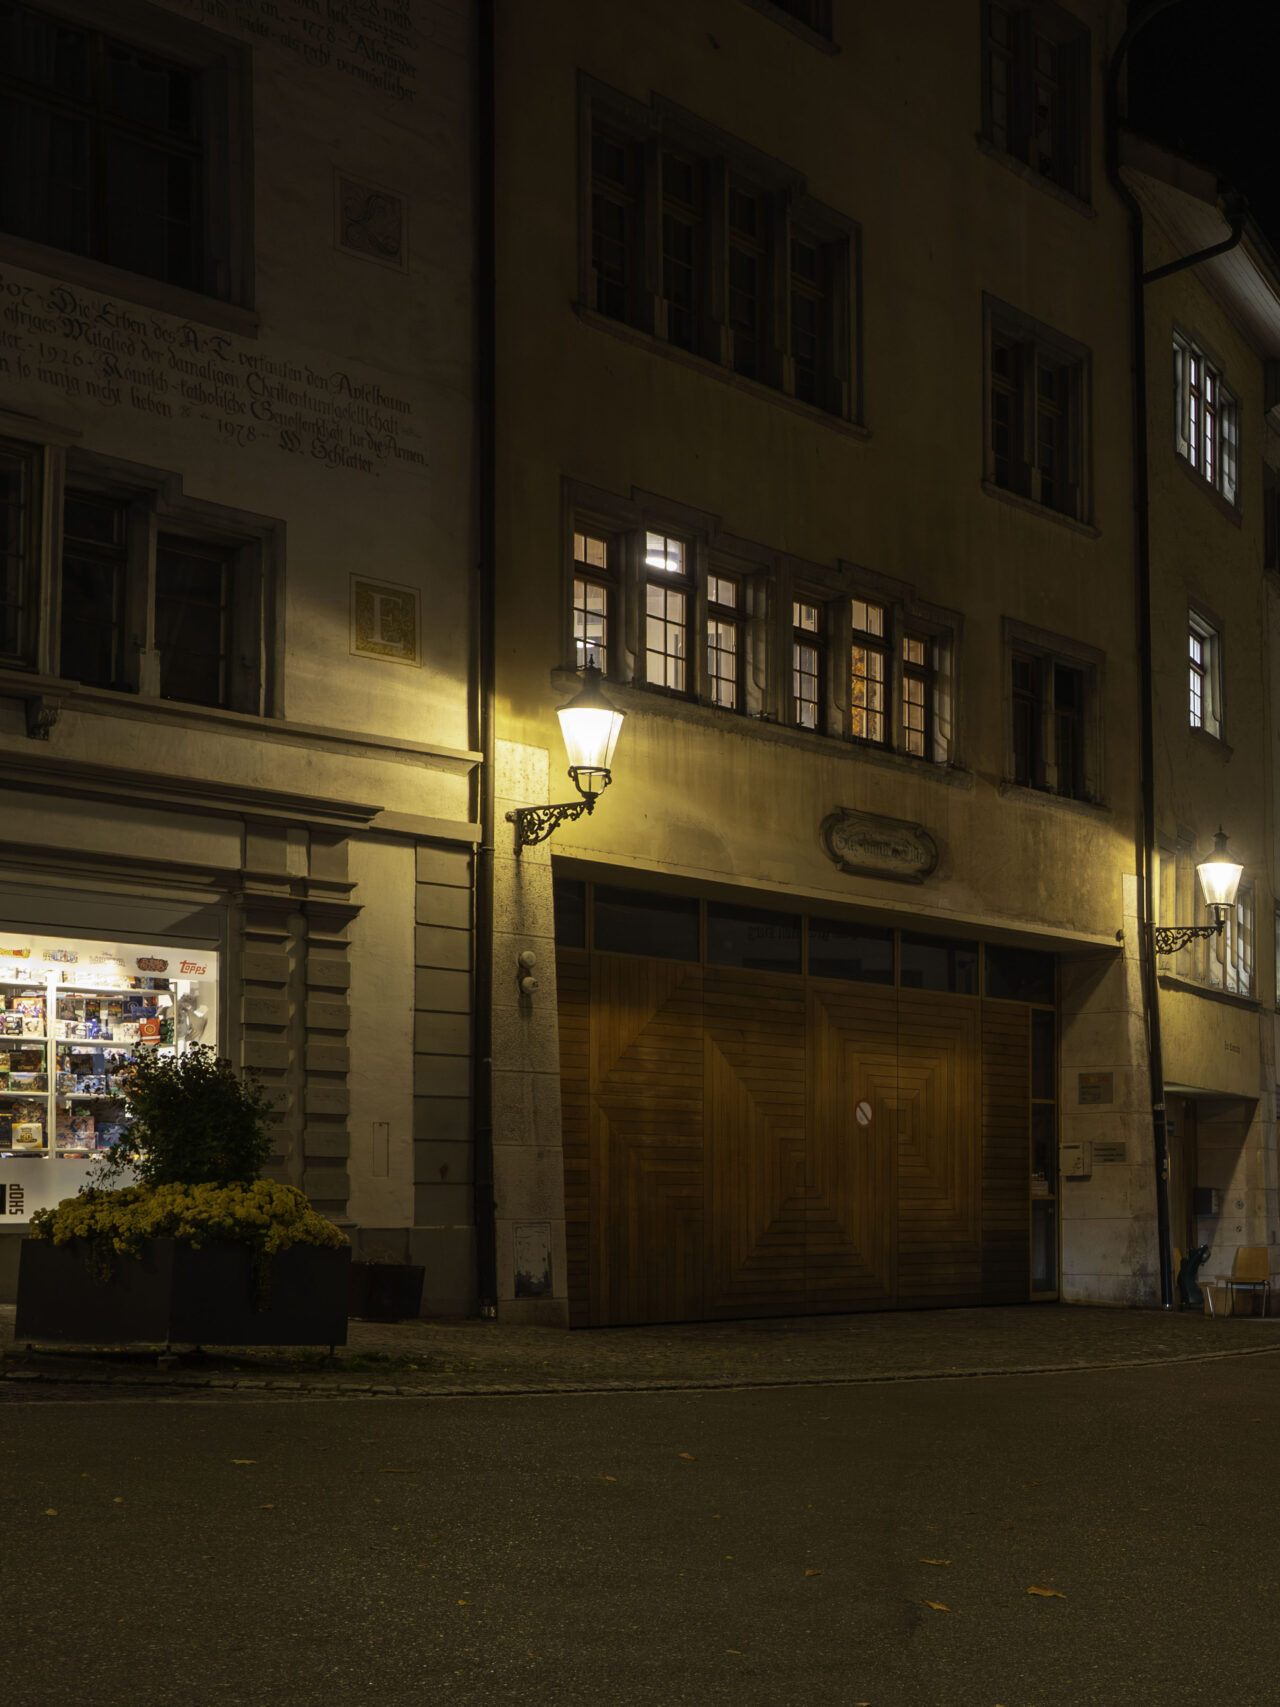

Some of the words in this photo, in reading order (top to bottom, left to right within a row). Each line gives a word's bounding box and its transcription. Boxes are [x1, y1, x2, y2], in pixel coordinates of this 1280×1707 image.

[39, 342, 84, 368] 1926
[94, 302, 148, 338] Erben
[304, 364, 329, 390] den
[140, 338, 165, 362] der
[167, 345, 240, 391] damaligen
[85, 378, 122, 408] nicht
[130, 385, 173, 419] lieben
[217, 418, 258, 449] 1978
[8, 1183, 25, 1216] SHOP
